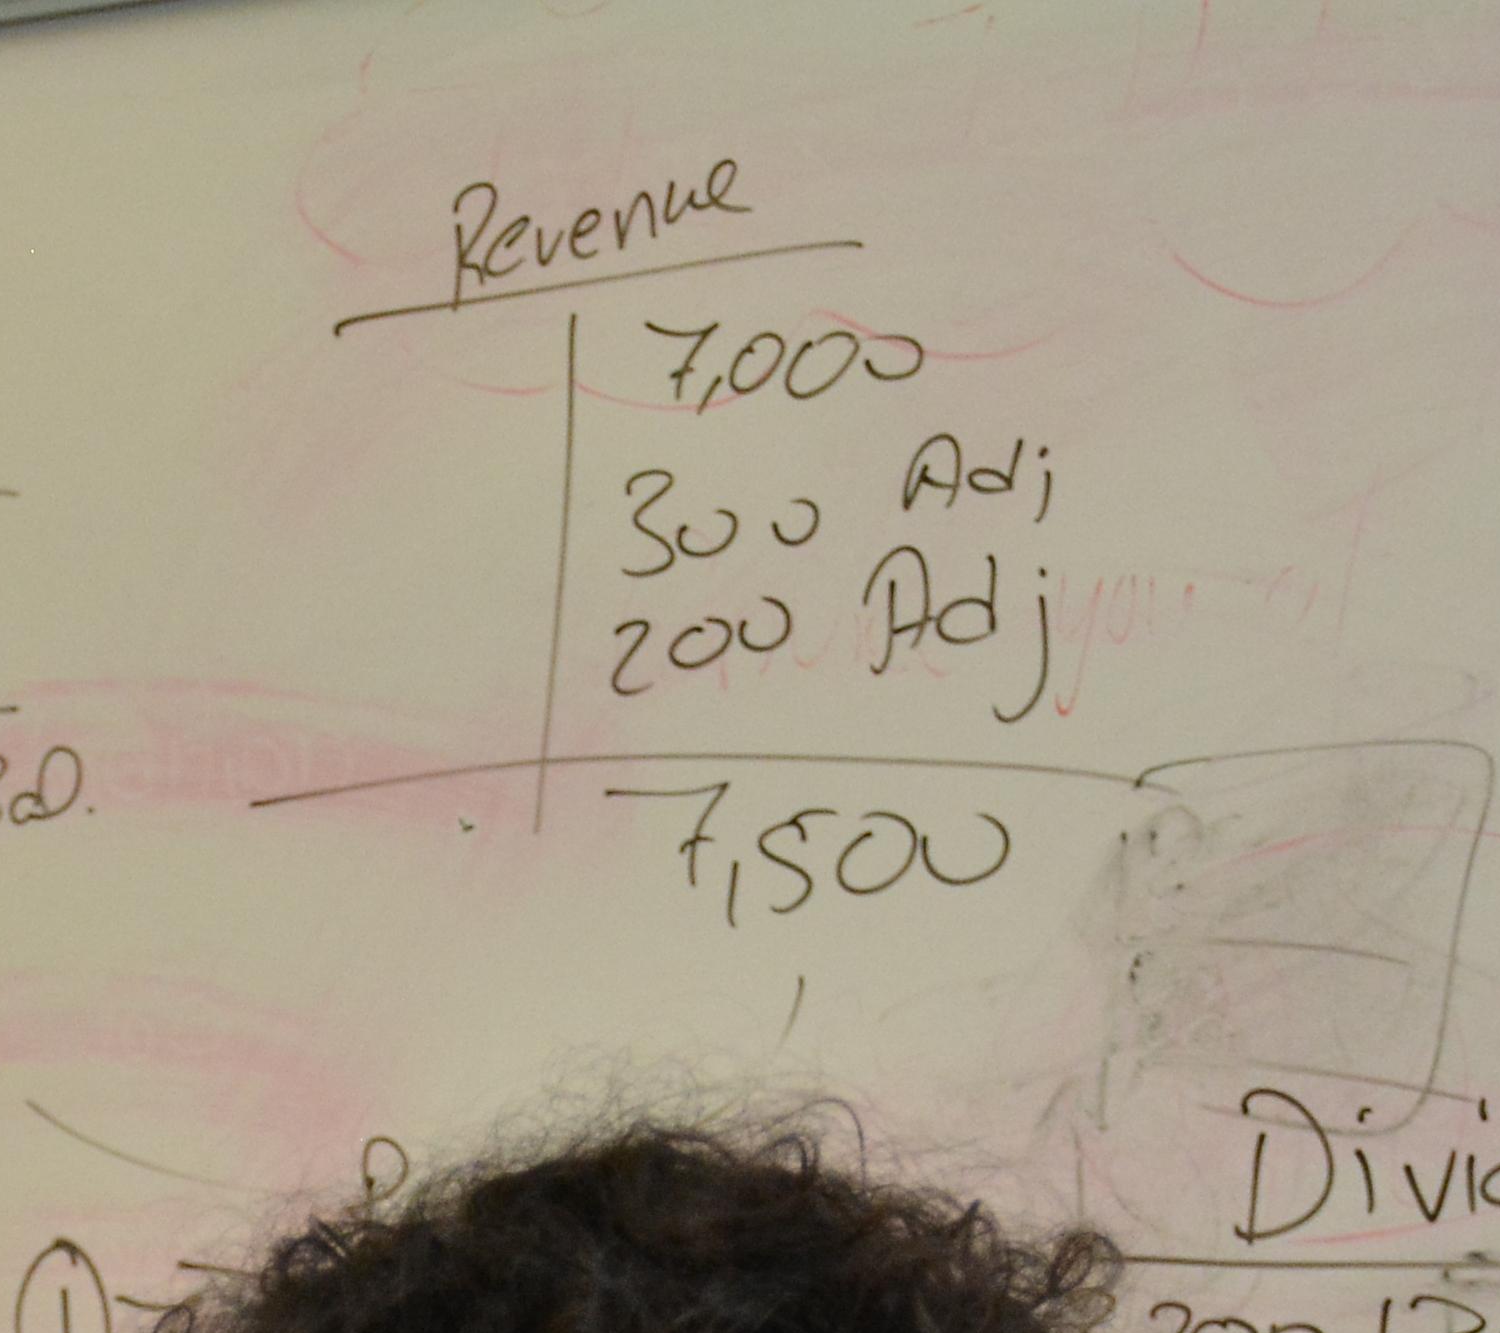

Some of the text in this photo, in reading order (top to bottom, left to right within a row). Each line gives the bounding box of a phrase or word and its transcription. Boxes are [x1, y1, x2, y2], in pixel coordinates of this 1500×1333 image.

[451, 159, 753, 312] Revenue
[644, 321, 924, 415] 7,000
[622, 433, 1053, 577] 300 Adj
[610, 595, 792, 696] 200
[861, 545, 1050, 724] Adj
[604, 780, 1010, 928] 7,500
